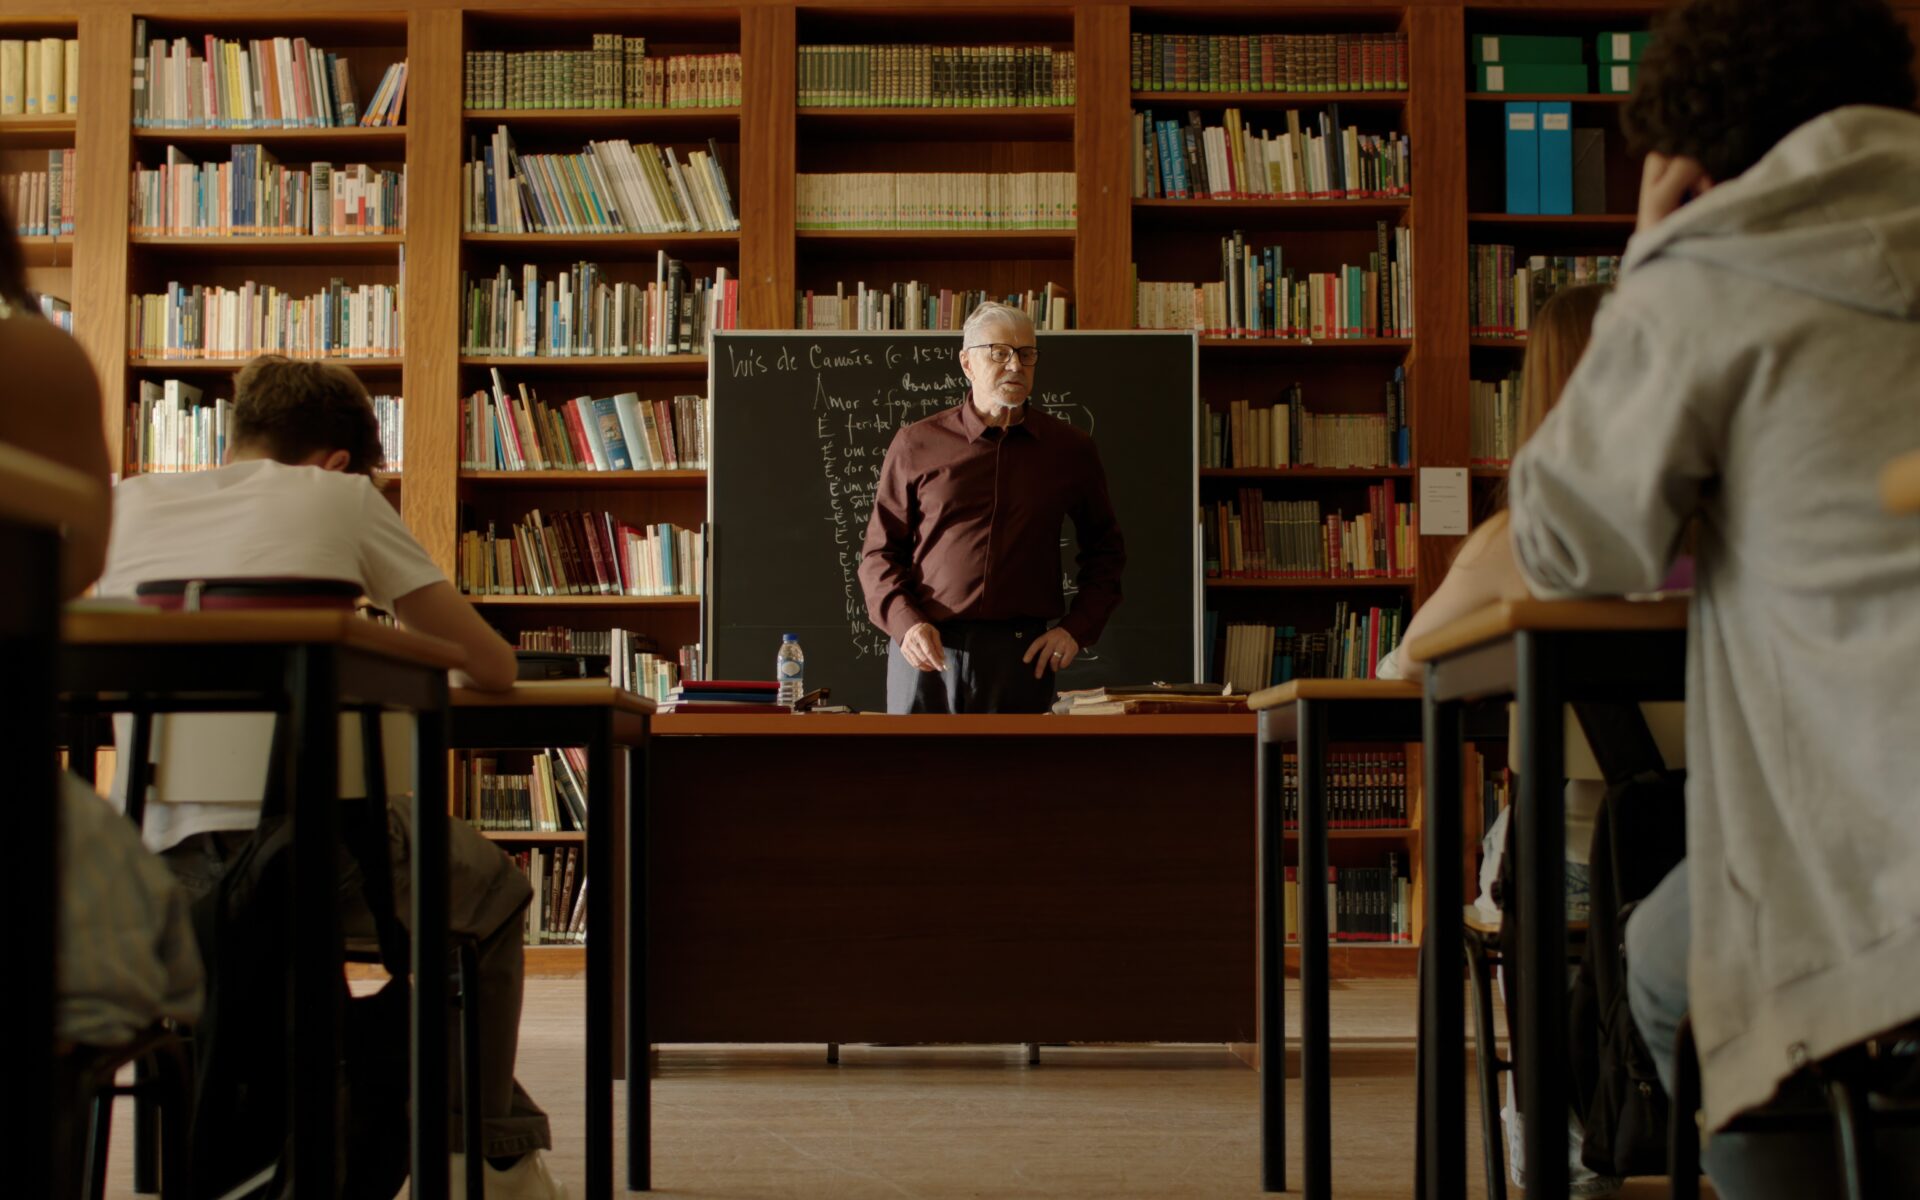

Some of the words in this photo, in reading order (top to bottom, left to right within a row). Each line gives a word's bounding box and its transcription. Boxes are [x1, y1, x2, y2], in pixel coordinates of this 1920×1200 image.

[777, 345, 798, 371] de
[913, 344, 954, 365] 1524
[813, 372, 860, 411] Amor
[884, 389, 912, 427] fogo
[1042, 391, 1071, 404] ver
[844, 446, 866, 459] um
[844, 460, 864, 477] dor
[844, 482, 862, 494] um
